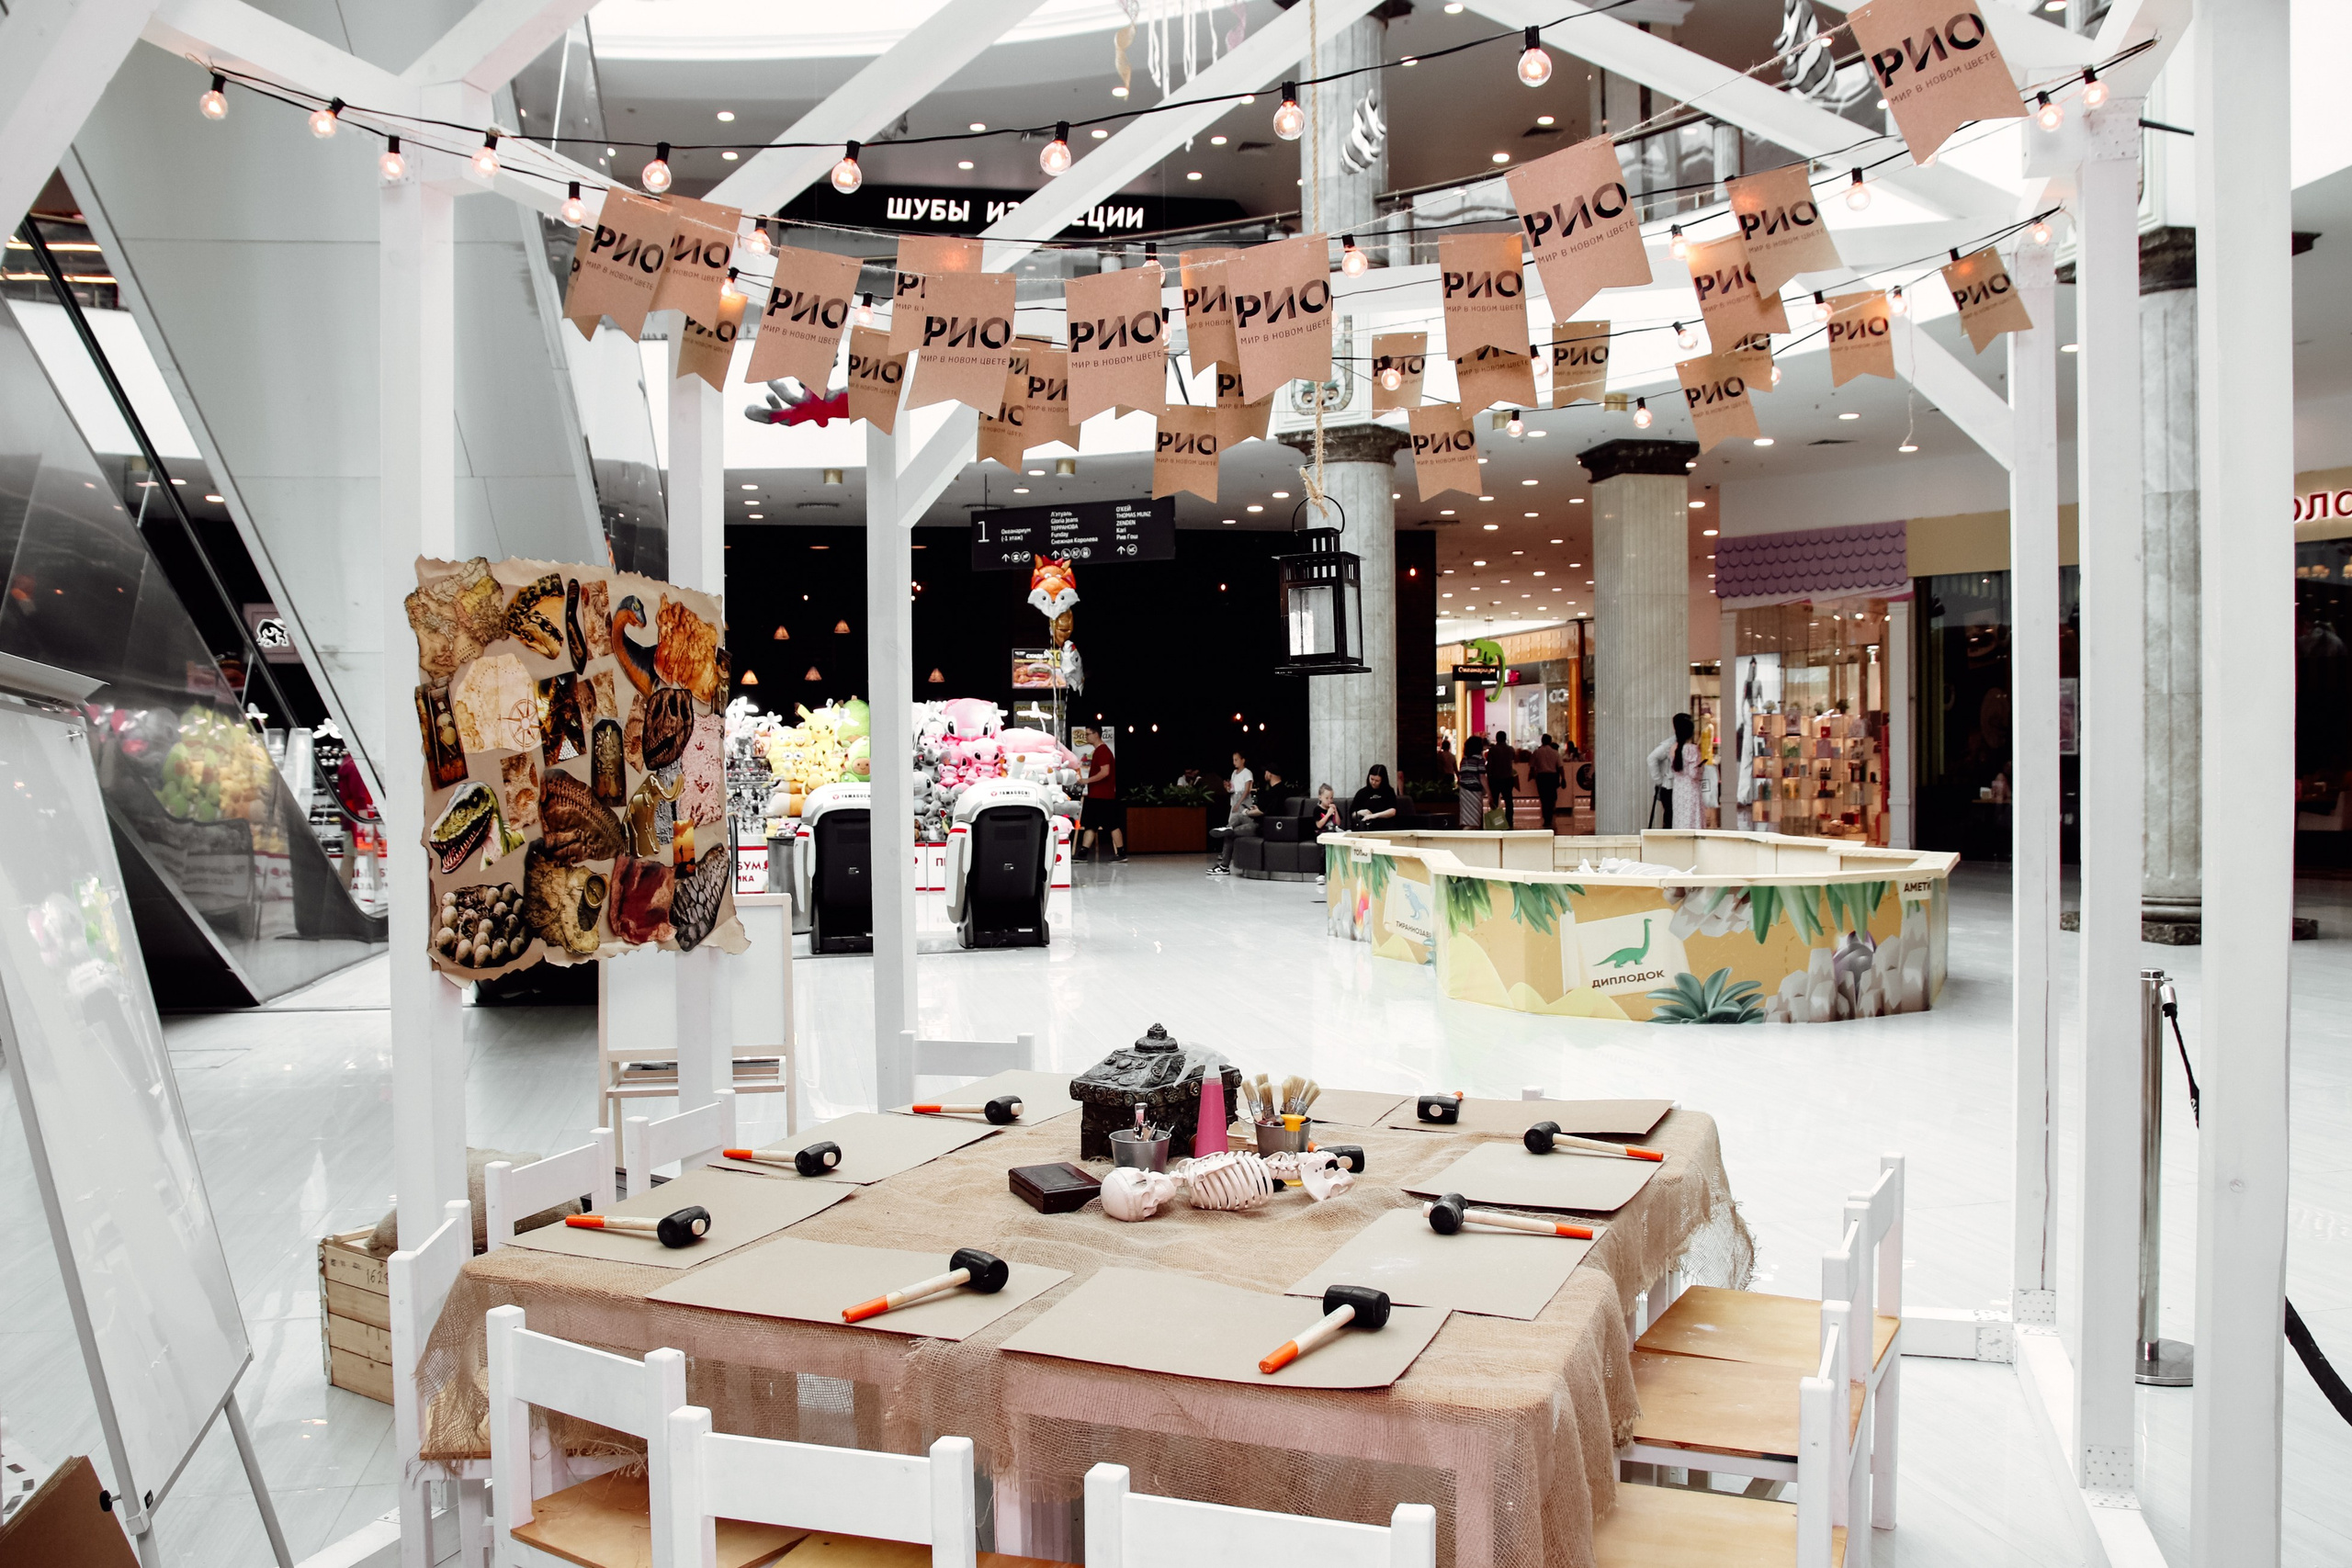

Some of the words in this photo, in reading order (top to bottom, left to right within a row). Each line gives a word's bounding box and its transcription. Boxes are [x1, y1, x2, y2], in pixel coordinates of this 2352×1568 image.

[1871, 12, 1985, 88] РИО
[1889, 87, 1913, 104] МИР
[1923, 65, 1962, 88] НОВОМ
[1962, 49, 1997, 72] ЦВЕТЕ
[887, 197, 970, 222] ШУБЫ
[1523, 182, 1628, 248] РИО
[1738, 200, 1818, 241] РИО
[591, 224, 663, 273] РИО
[671, 234, 730, 268] ИО
[1537, 250, 1559, 265] МИР
[1569, 232, 1604, 254] НОВОМ
[1604, 218, 1636, 239] ЦВЕТЕ
[1747, 243, 1764, 253] МИР
[1772, 235, 1799, 247] НОВОМ
[1800, 227, 1826, 240] ЦВЕТЕ
[584, 260, 602, 270] МИР
[608, 268, 633, 282] НОВОМ
[633, 277, 653, 290] ЦВЕТЕ
[672, 267, 699, 278] НОВОМ
[700, 274, 723, 284] ЦВЕТЕ
[1443, 269, 1523, 299] РИО
[1183, 285, 1232, 317] РИ
[1236, 279, 1329, 328] РИО
[1702, 303, 1718, 312] МИР
[1726, 294, 1751, 306] НОВОМ
[1952, 273, 2011, 310] РИО
[766, 287, 848, 329] РИО
[1471, 304, 1497, 312] НОВОМ
[763, 323, 780, 333] МИР
[789, 330, 816, 342] НОВОМ
[818, 334, 840, 345] ЦВЕТЕ
[922, 316, 1011, 349] РИО
[1069, 310, 1161, 353] РИО
[1204, 319, 1232, 327] НОВОМ
[1239, 333, 1261, 345] МИР
[1272, 326, 1304, 340] НОВОМ
[1304, 316, 1331, 332] ЦВЕТЕ
[1828, 316, 1889, 343] РИО
[1554, 345, 1609, 366] РИО
[1735, 333, 1771, 351] ИО
[848, 355, 902, 383] РИО
[948, 355, 977, 364] НОВОМ
[979, 357, 1005, 366] ЦВЕТЕ
[1070, 359, 1091, 369] МИР
[1102, 355, 1133, 366] НОВОМ
[1135, 349, 1161, 361] ЦВЕТЕ
[1458, 368, 1473, 377] МИР
[1481, 363, 1505, 372] НОВОМ
[1507, 358, 1529, 368] ЦВЕТЕ
[1027, 376, 1068, 401] РИ
[1685, 376, 1746, 409] РИО
[1157, 431, 1217, 456] РИО
[1413, 429, 1475, 456] РИО
[978, 520, 989, 543] 1
[1001, 527, 1032, 536] Океанариум
[1591, 970, 1665, 988] ДИПЛОДОК
